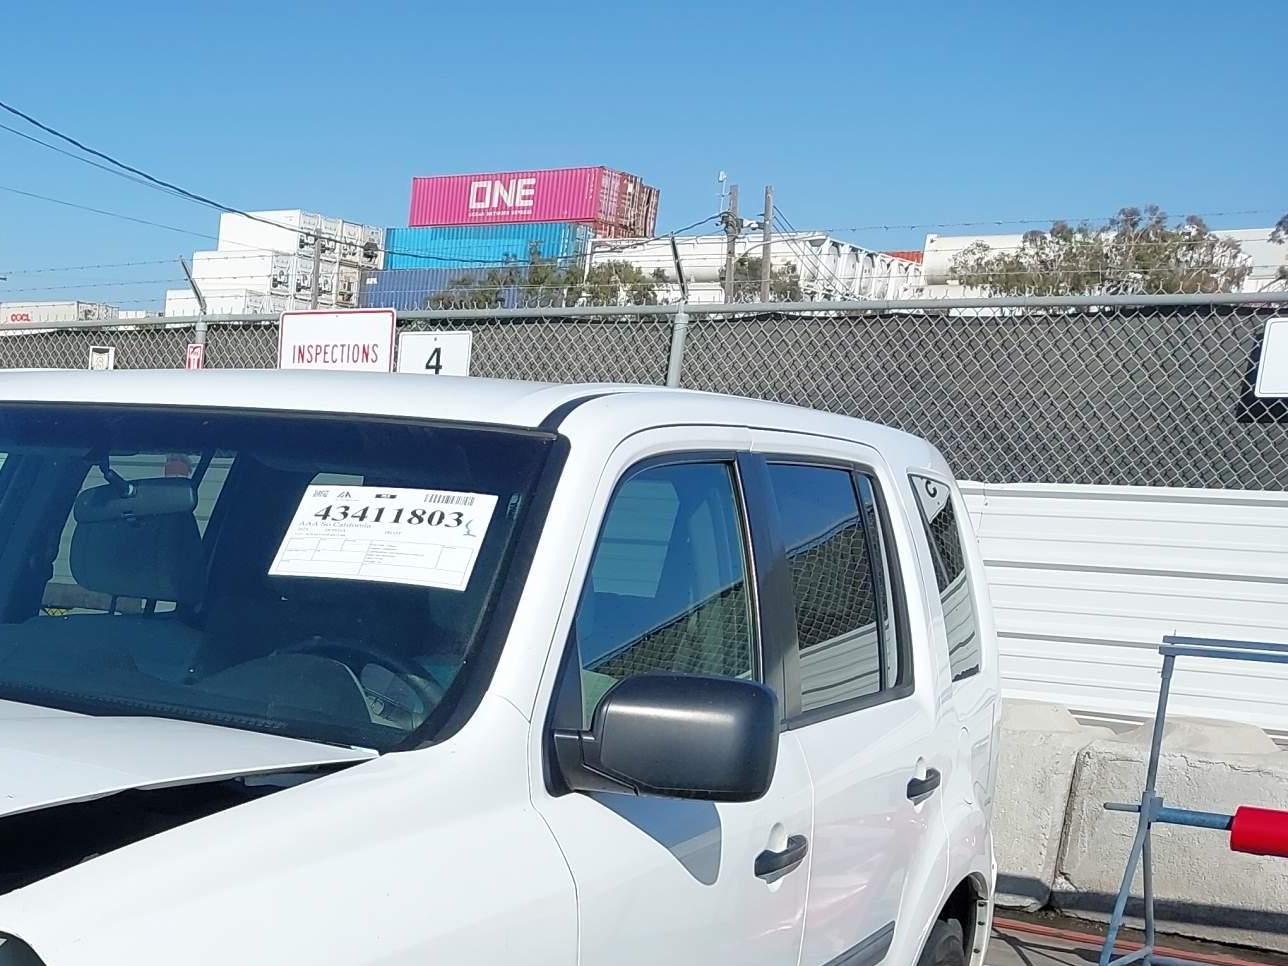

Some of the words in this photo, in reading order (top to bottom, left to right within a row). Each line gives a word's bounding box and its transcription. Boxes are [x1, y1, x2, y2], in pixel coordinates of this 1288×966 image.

[469, 178, 536, 209] ONE
[292, 343, 380, 364] INSPECTIONS
[424, 347, 443, 375] 4
[314, 504, 464, 528] 43411803
